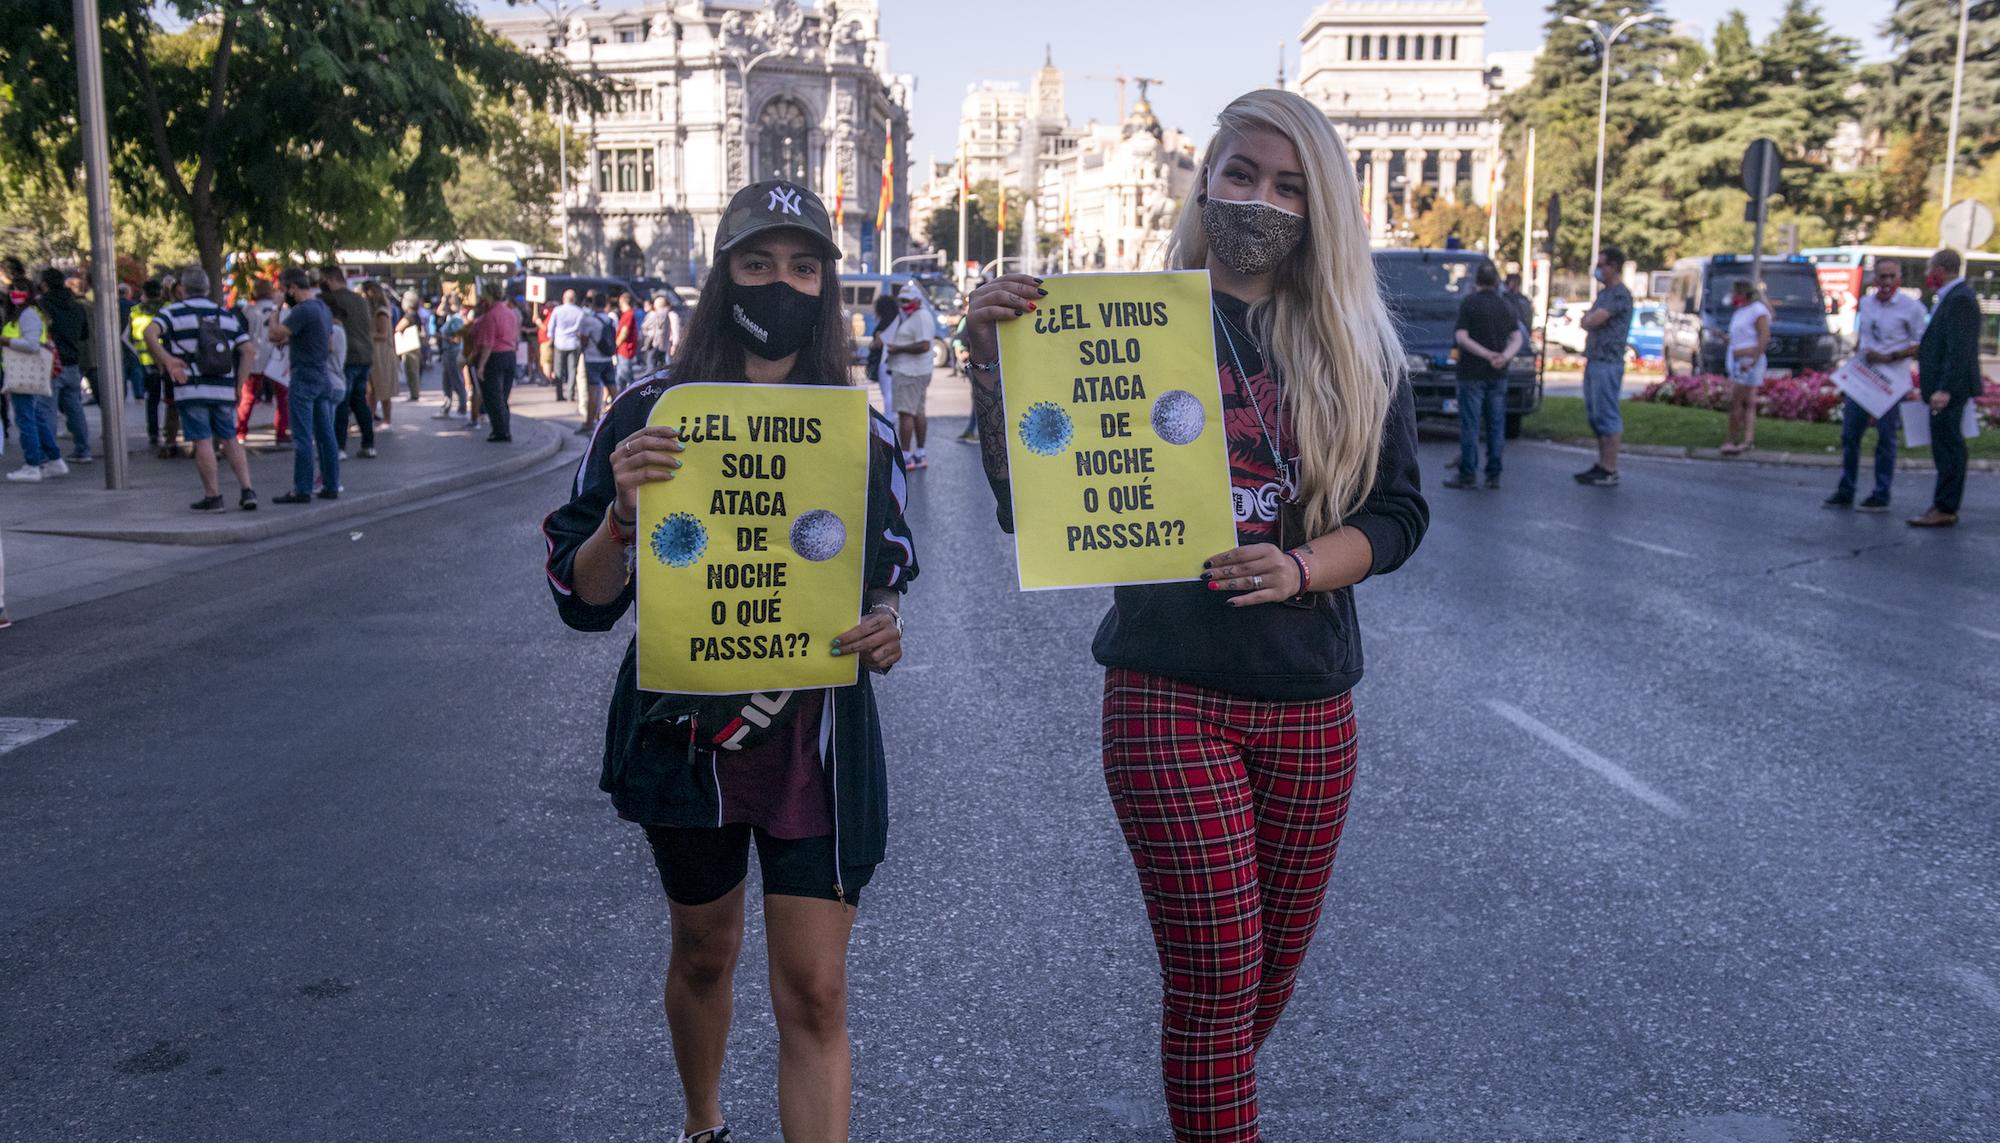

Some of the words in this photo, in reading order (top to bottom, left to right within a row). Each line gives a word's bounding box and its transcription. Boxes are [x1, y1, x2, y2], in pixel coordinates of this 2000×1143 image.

[768, 186, 802, 217] NY
[1034, 303, 1091, 334] ¿¿EL
[1098, 301, 1169, 328] VIRUS
[1079, 338, 1141, 366] SOLO
[1072, 374, 1146, 404] ATACA
[678, 414, 737, 444] ¿¿EL
[747, 415, 822, 444] VIRUS
[1100, 412, 1132, 439] DE
[721, 453, 786, 480] SOLO
[1075, 447, 1155, 477] NOCHE
[709, 489, 787, 516] ATACA
[1083, 487, 1099, 513] O
[1108, 477, 1154, 515] QUÉ
[736, 527, 768, 552] DE
[1066, 519, 1186, 552] PASSSA??
[706, 562, 787, 589] NOCHE
[711, 600, 727, 626] O
[736, 590, 782, 627] QUÉ
[689, 632, 811, 662] PASSSA??
